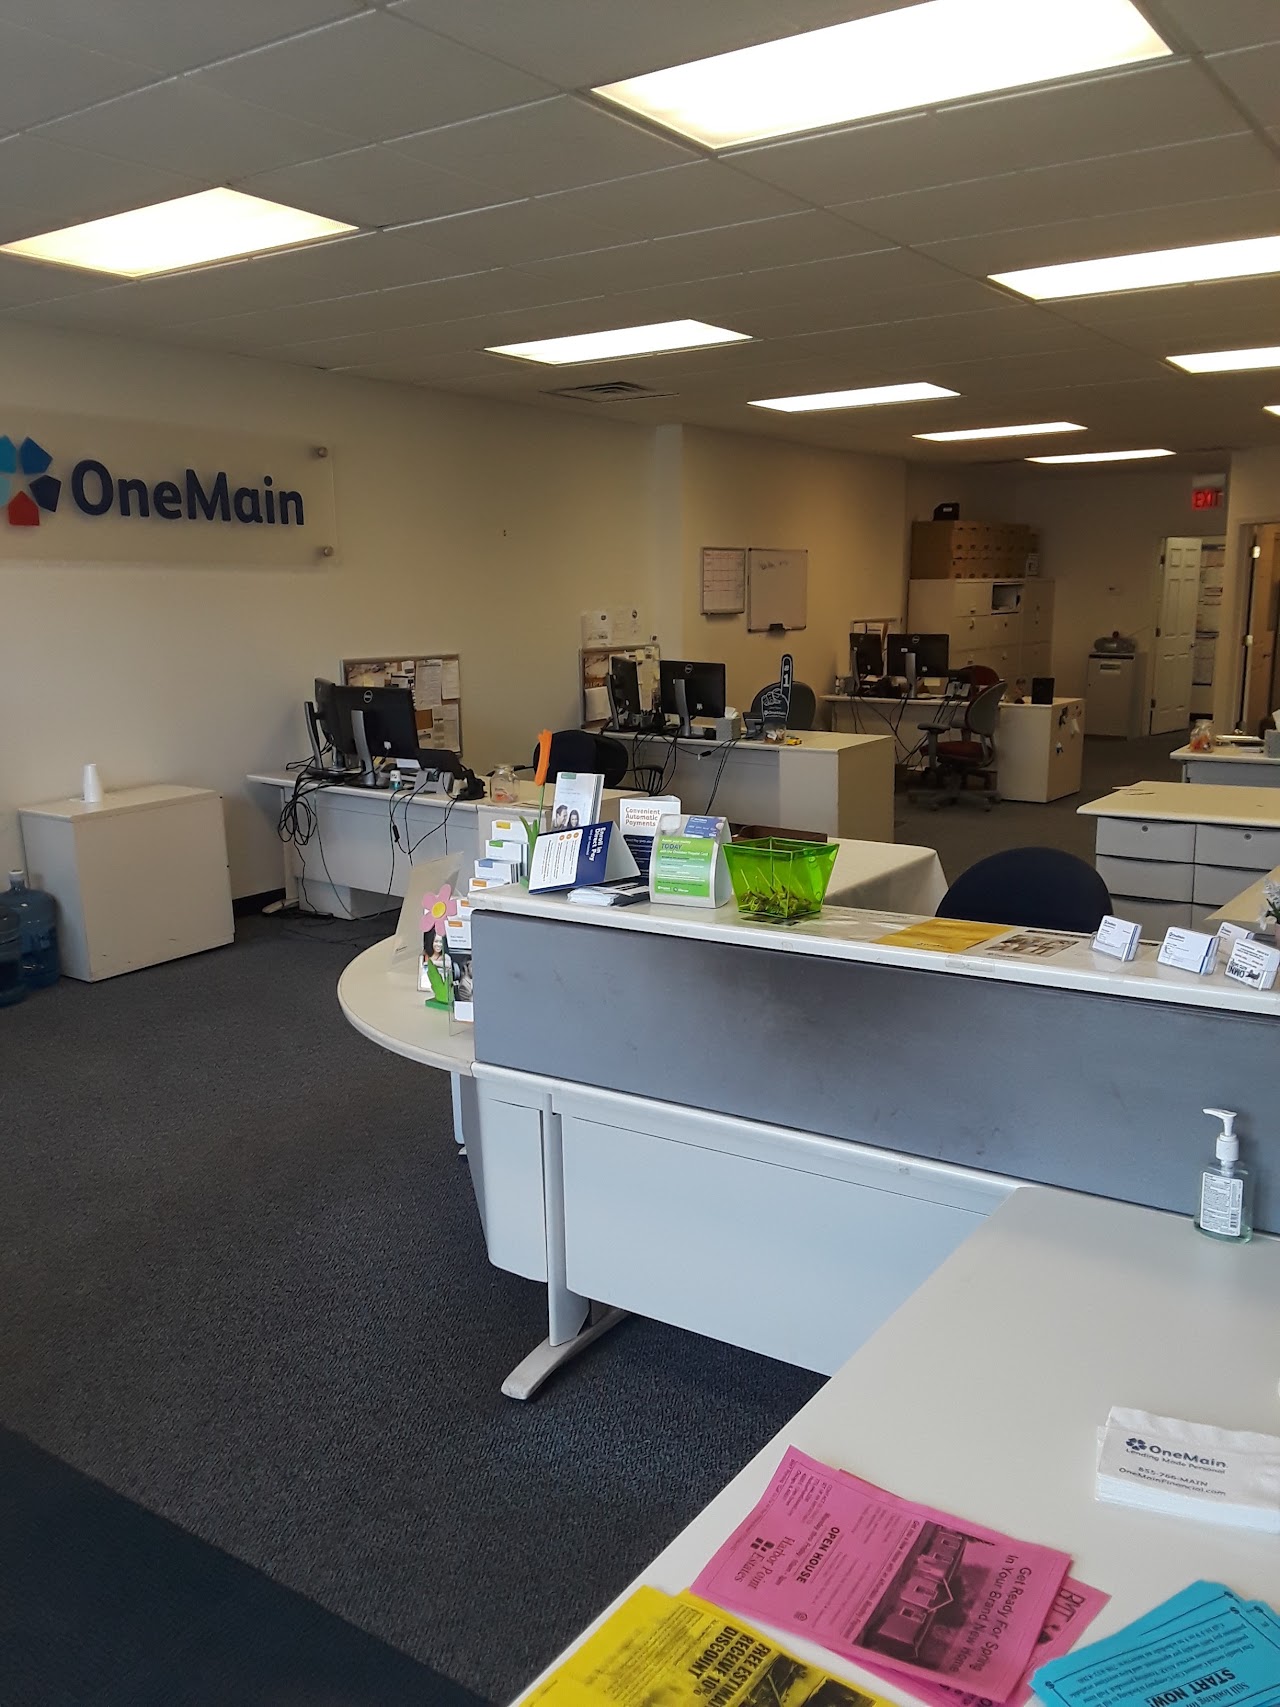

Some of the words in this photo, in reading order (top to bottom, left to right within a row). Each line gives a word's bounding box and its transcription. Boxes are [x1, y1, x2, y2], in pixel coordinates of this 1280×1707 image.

[72, 459, 304, 525] OneMain
[1194, 489, 1222, 508] EXIT
[625, 807, 661, 815] Convenient
[625, 813, 658, 821] Automatic
[625, 819, 656, 827] Payments
[591, 827, 600, 848] Direct
[597, 825, 606, 846] Enroll
[587, 847, 596, 861] Pay
[1126, 1449, 1160, 1462] Lending
[1162, 1458, 1187, 1468] Made
[1188, 1463, 1226, 1475] Personal
[1149, 1445, 1227, 1469] OneMain
[1118, 1467, 1226, 1497] OneMainFinancial.com
[766, 1536, 795, 1566] Harbor
[818, 1526, 840, 1552] OPEN
[734, 1552, 766, 1583] Estates
[796, 1552, 824, 1584] HOUSE
[1004, 1554, 1019, 1564] In
[748, 1566, 773, 1590] Point
[994, 1566, 1013, 1588] Your
[1014, 1566, 1032, 1586] Get
[978, 1590, 1002, 1623] Brand
[997, 1586, 1025, 1619] Ready
[1053, 1588, 1087, 1623] BMT
[966, 1622, 987, 1645] New
[992, 1619, 1009, 1641] For
[688, 1625, 739, 1680] DISCOUNT
[717, 1633, 756, 1677] RECEIVE
[743, 1642, 772, 1668] FREE
[949, 1646, 972, 1673] Home
[969, 1640, 999, 1672] Spring
[693, 1674, 721, 1698] 10%
[1188, 1668, 1236, 1695] START
[1229, 1682, 1251, 1697] Still
[1196, 1688, 1233, 1705] looking
